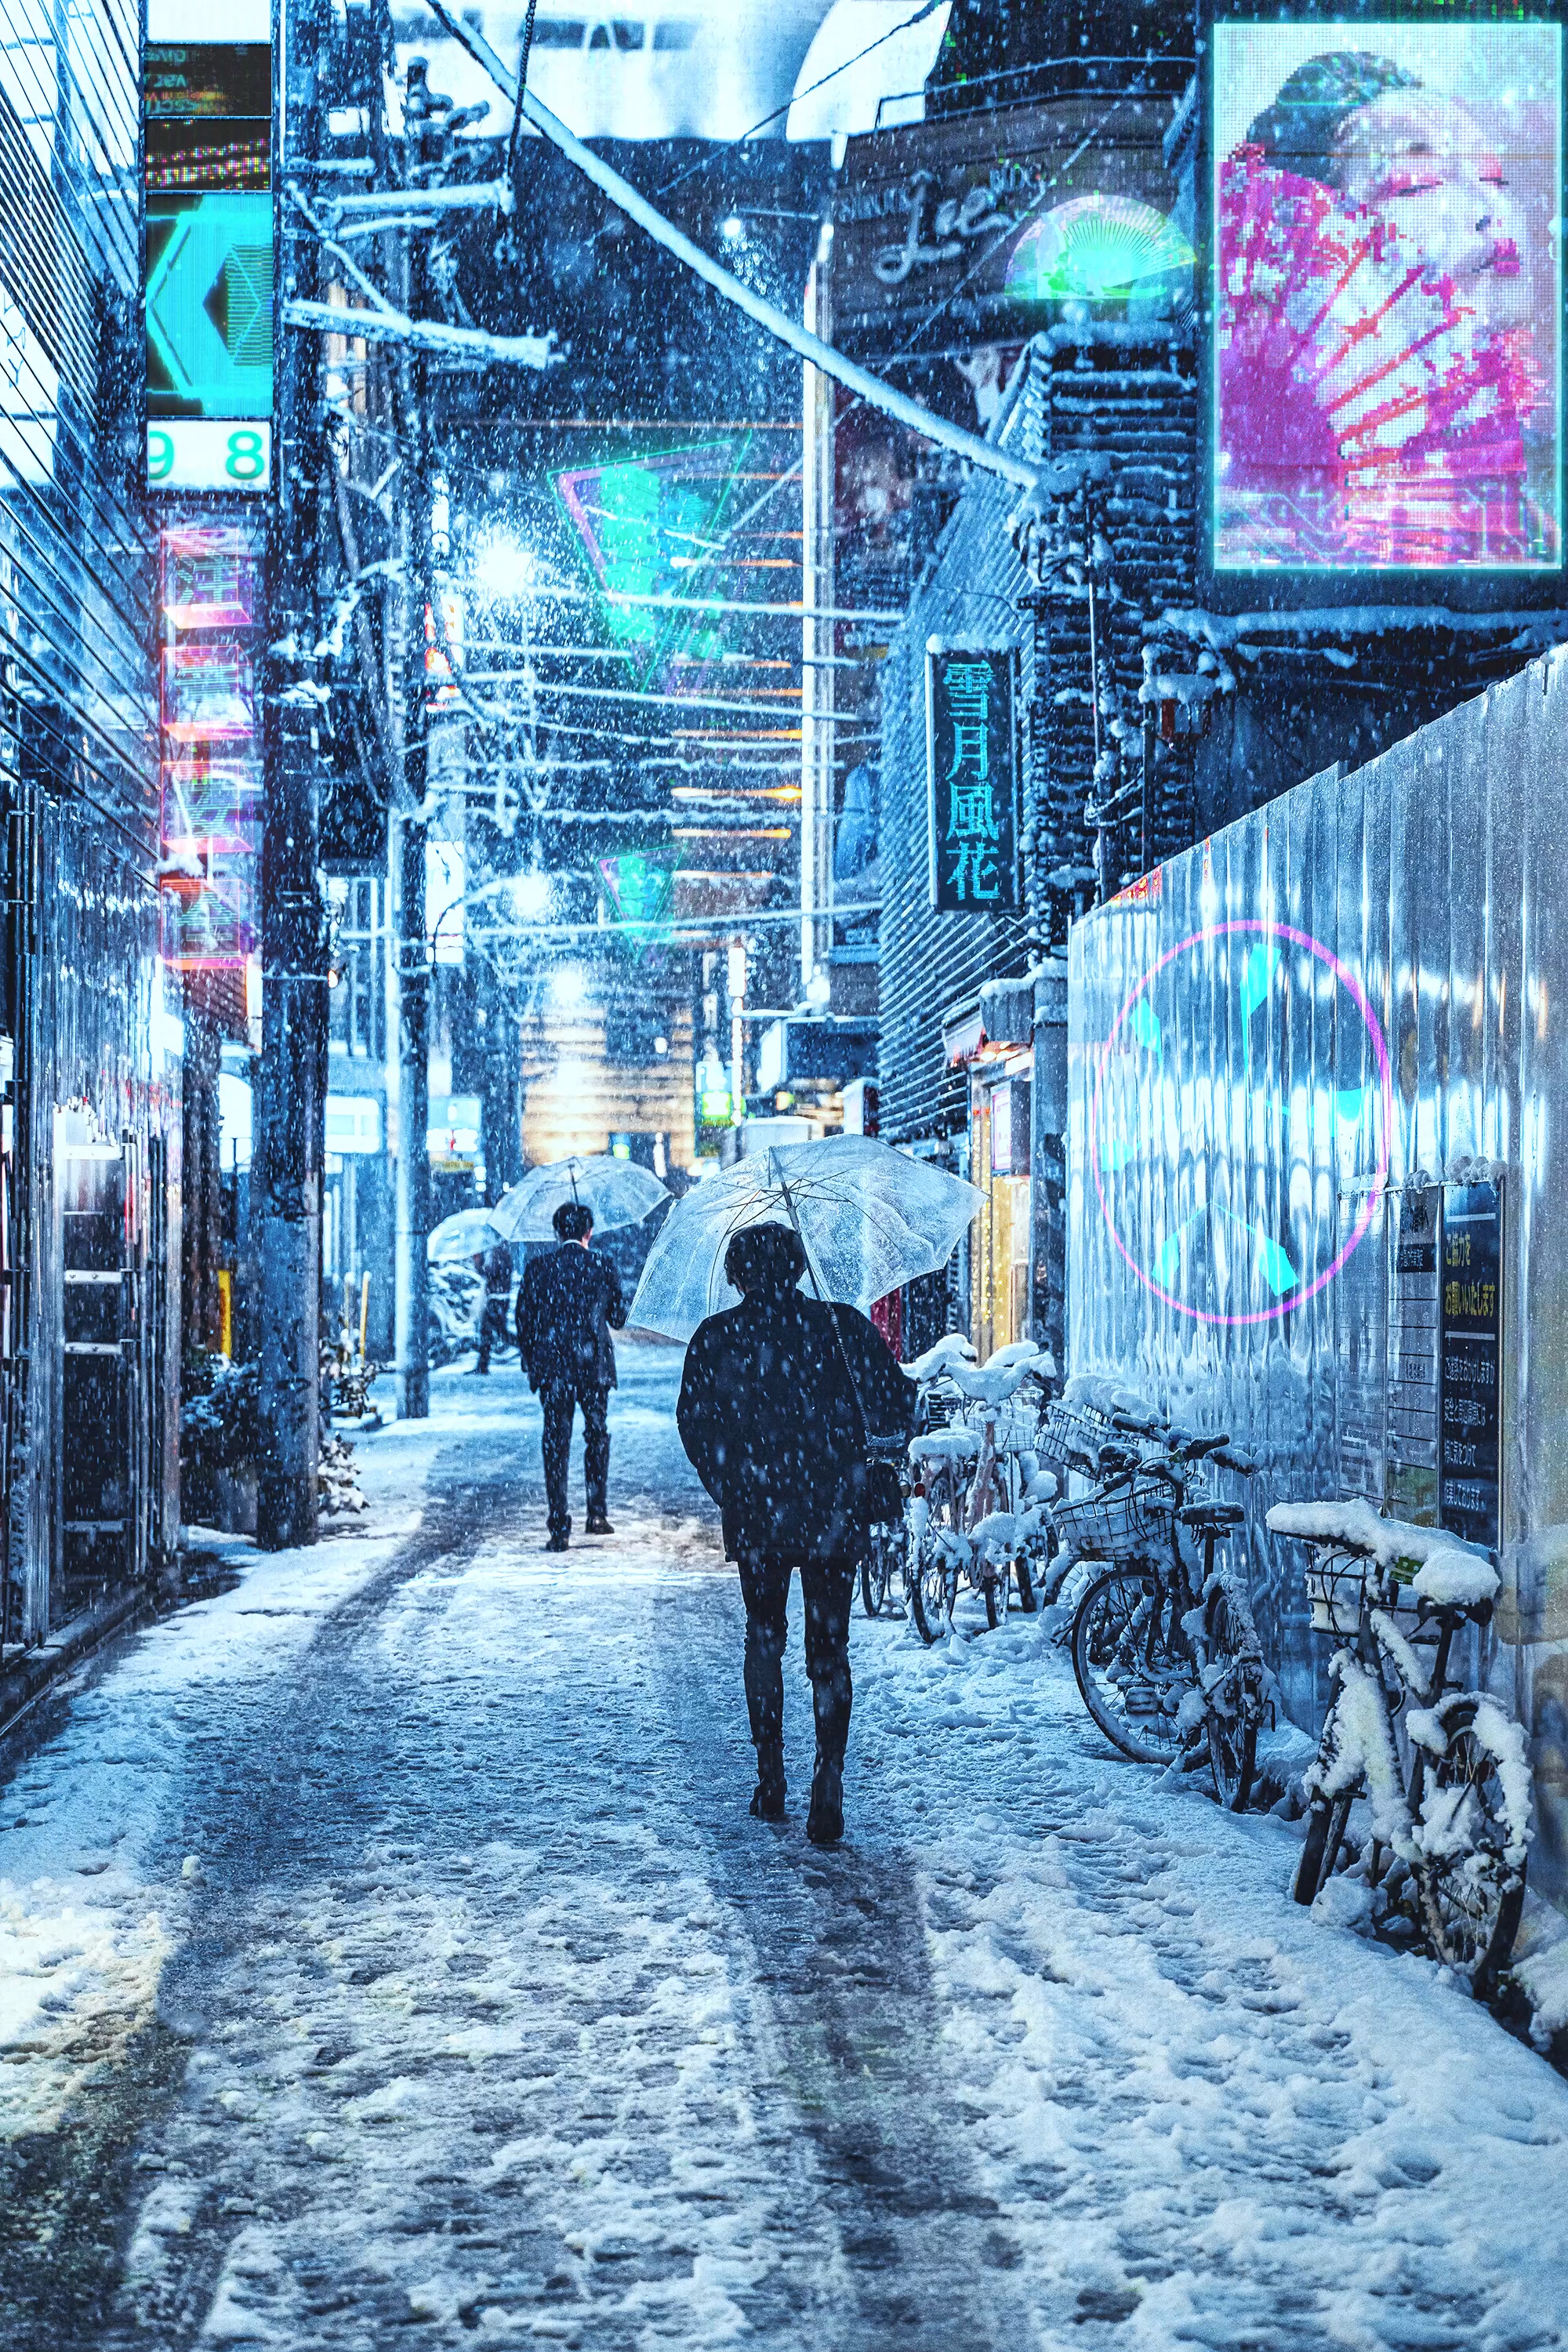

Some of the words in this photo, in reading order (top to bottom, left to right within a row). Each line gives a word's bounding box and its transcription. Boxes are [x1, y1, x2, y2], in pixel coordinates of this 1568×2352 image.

[226, 431, 264, 480] 8
[943, 660, 1000, 900] 雪月風花
